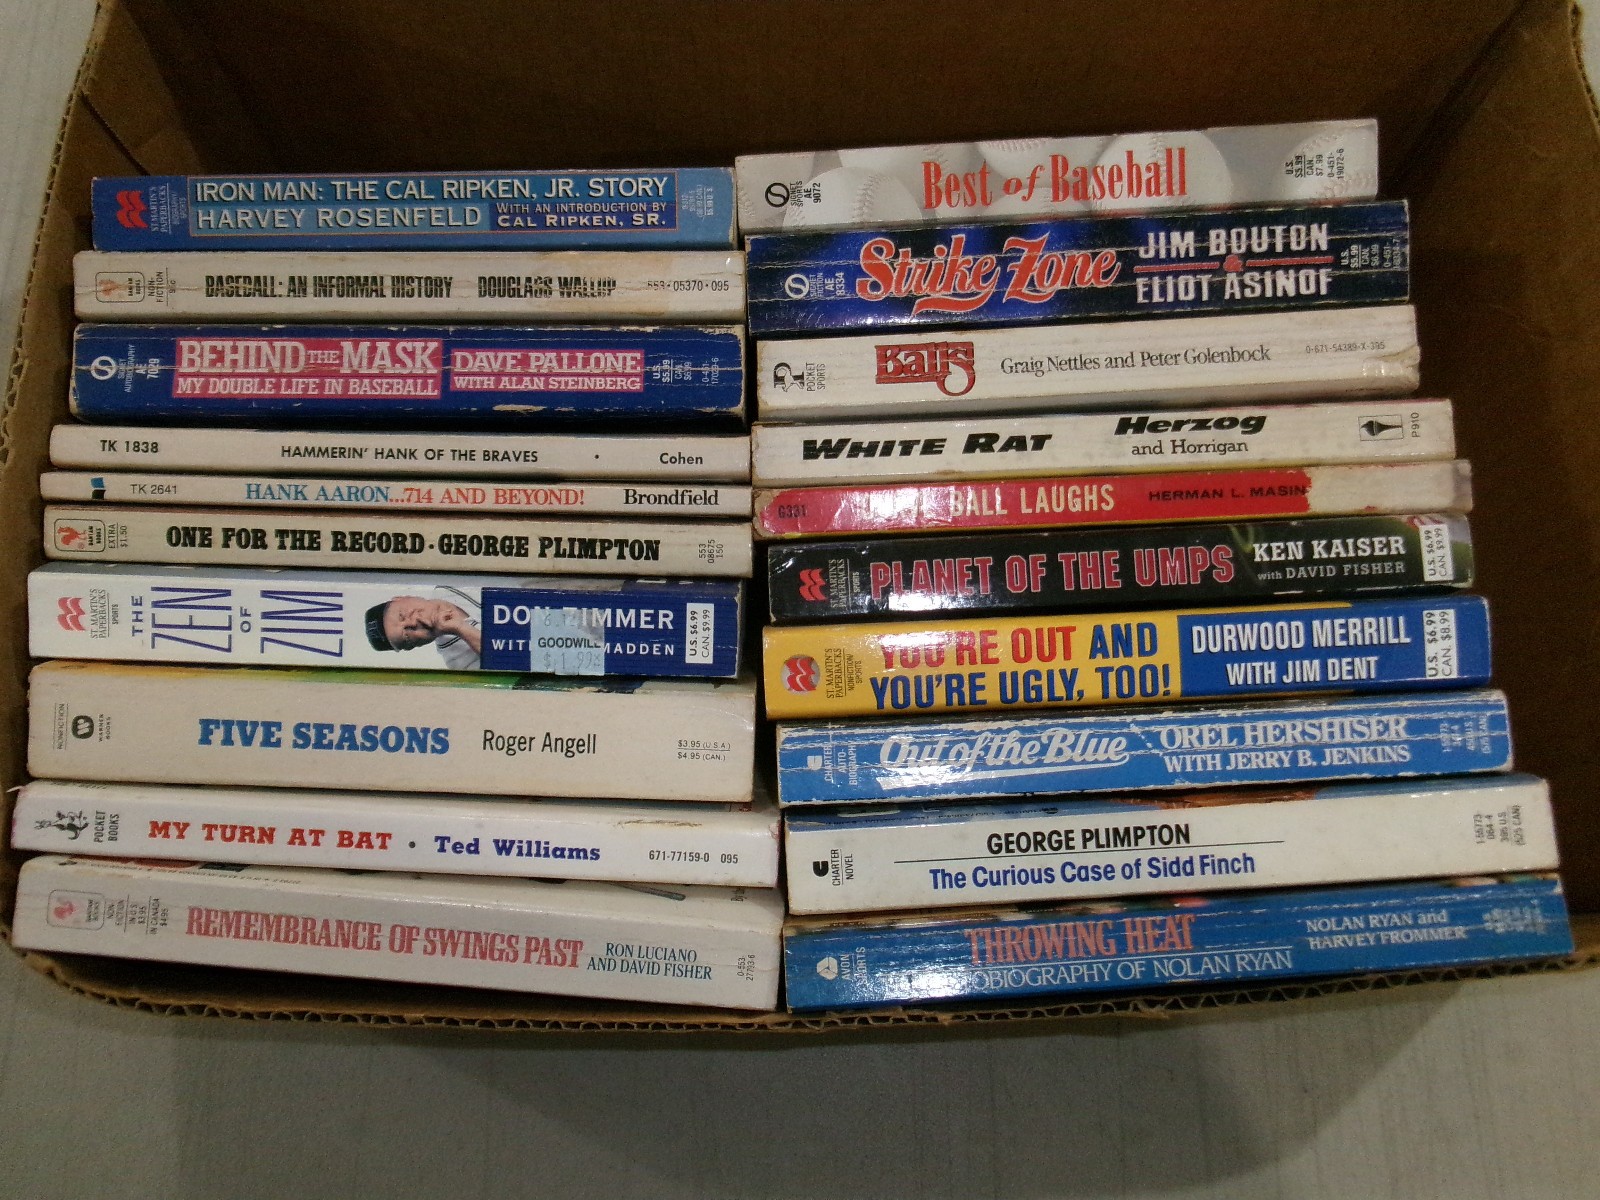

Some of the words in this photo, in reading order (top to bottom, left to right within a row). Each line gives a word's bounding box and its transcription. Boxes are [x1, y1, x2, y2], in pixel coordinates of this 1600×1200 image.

[197, 182, 255, 202] IRON
[264, 181, 323, 201] MAN:
[331, 180, 378, 200] THE
[385, 180, 434, 200] CAL
[442, 179, 536, 201] RIPKEN,
[545, 178, 580, 198] JR.
[588, 177, 668, 198] STORY
[922, 159, 993, 209] Best
[1003, 165, 1046, 201] of
[1049, 147, 1187, 203] Baseball
[813, 182, 822, 204] 9072
[198, 208, 305, 229] HARVEY
[317, 207, 482, 228] ROSENFELD
[556, 202, 646, 212] INTRODUCTION
[545, 214, 624, 228] RIPKEN,
[1138, 231, 1194, 258] JIM
[1209, 223, 1328, 256] BOUTON
[856, 234, 1001, 303] Strike
[1002, 232, 1122, 303] Zone
[205, 275, 283, 298] BASEBALL:
[287, 275, 308, 298] AN
[313, 275, 386, 298] INFORMAL
[391, 275, 453, 298] HISTORY
[836, 272, 844, 296] 8334
[1136, 275, 1212, 303] ELIOT
[1224, 268, 1333, 300] ASINOF
[179, 341, 305, 374] BEHIND
[308, 350, 340, 365] THE
[340, 341, 438, 374] MASK
[454, 352, 521, 373] DAVE
[530, 352, 641, 373] PALLONE
[875, 341, 976, 397] Balls
[1000, 357, 1043, 377] Graig
[1046, 353, 1100, 372] Nettles
[1105, 353, 1136, 369] and
[1140, 350, 1181, 368] Peter
[1183, 344, 1271, 366] Golenbock
[176, 378, 202, 395] MY
[208, 379, 275, 395] DOUBLE
[280, 379, 319, 395] LIFE
[348, 379, 438, 396] BASEBALL
[454, 376, 495, 389] WITH
[499, 377, 544, 390] ALAN
[548, 377, 642, 390] STEINBERG
[1114, 414, 1267, 436] Herzog
[100, 440, 118, 452] TK
[124, 441, 159, 453] 1838
[281, 446, 368, 459] HAMMERIN'
[374, 447, 418, 460] HANK
[482, 450, 538, 462] BRAVES
[659, 452, 703, 465] Cohen
[802, 437, 947, 460] WHITE
[962, 433, 1053, 455] RAT
[1170, 439, 1248, 456] Horrigan
[129, 483, 147, 495] TK
[150, 483, 178, 495] 2641
[246, 484, 310, 501] HANK
[440, 488, 486, 505] AND
[494, 488, 584, 506] BEYOND!
[623, 488, 719, 506] Brondfield
[951, 487, 1008, 518] BALL
[1020, 484, 1115, 514] LAUGHS
[1148, 488, 1224, 502] HERMAN
[1250, 486, 1307, 498] MASIN
[166, 526, 212, 549] ONE
[221, 528, 268, 551] FOR
[275, 529, 321, 551] THE
[331, 530, 425, 554] RECORD
[437, 533, 529, 557] GEORGE
[538, 536, 661, 561] PLIMPTON
[1253, 541, 1303, 562] KEN
[1312, 536, 1406, 560] KAISER
[1424, 530, 1435, 554] $6.99
[869, 556, 994, 600] PLANET
[1005, 554, 1047, 593] OF
[1058, 550, 1122, 591] THE
[1134, 544, 1235, 587] UMPS
[1285, 564, 1336, 579] DAVID
[1343, 561, 1406, 577] FISHER
[151, 587, 232, 653] ZEN
[260, 590, 343, 657] ZIM
[690, 610, 698, 635] $6.99
[702, 609, 711, 633] $9.99
[1439, 611, 1451, 641] $8.99
[1011, 625, 1077, 665] OUT
[1088, 621, 1158, 660] AND
[1192, 620, 1306, 654] DURWOOD
[1312, 615, 1411, 648] MERRILL
[1226, 662, 1276, 685] WITH
[1282, 659, 1320, 684] JIM
[1327, 656, 1379, 681] DENT
[1427, 652, 1438, 677] U.S.
[870, 671, 988, 711] YOU'RE
[999, 667, 1085, 706] UGLY,
[1094, 664, 1171, 698] TOO!
[198, 718, 283, 749] FIVE
[292, 721, 450, 755] SEASONS
[483, 729, 536, 757] Roger
[541, 731, 597, 758] Angell
[677, 740, 701, 748] $3.95
[1041, 727, 1128, 764] Blue
[1160, 725, 1239, 750] OREL
[1244, 717, 1409, 746] HERSHISER
[677, 751, 701, 760] $4.95
[1163, 754, 1222, 774] WITH
[1226, 752, 1293, 771] JERRY
[1321, 745, 1411, 766] JENKINS
[94, 810, 106, 843] POCKET
[108, 813, 120, 841] BOOKS
[148, 821, 191, 839] MY
[201, 823, 276, 845] TURN
[287, 828, 326, 847] AT
[337, 830, 393, 850] BAT
[987, 830, 1075, 855] GEORGE
[1082, 824, 1190, 849] PLIMPTON
[434, 835, 480, 855] Ted
[493, 838, 601, 862] Williams
[648, 850, 710, 863] 671-77159-0
[720, 853, 739, 864] 095
[831, 848, 841, 886] CHARTER
[845, 853, 854, 880] NOVEL
[929, 868, 966, 889] The
[972, 864, 1055, 887] Curious
[1060, 861, 1116, 884] Case
[1121, 858, 1142, 881] of
[1146, 855, 1194, 878] Sidd
[1199, 852, 1255, 875] Finch
[186, 905, 382, 952] REMEMBRANCE
[389, 923, 421, 954] OF
[423, 927, 521, 963] SWINGS
[523, 936, 585, 969] PAST
[1306, 917, 1363, 933] NOLAN
[1369, 914, 1412, 930] RYAN
[964, 920, 1117, 966] THROWING
[1124, 913, 1196, 954] HEAT
[1308, 932, 1378, 950] HARVEY
[1380, 925, 1468, 946] FROMMER
[605, 942, 635, 958] RON
[637, 944, 698, 963] LUCIANO
[1154, 953, 1231, 978] NOLAN
[1236, 949, 1293, 973] RYAN
[587, 956, 618, 972] AND
[620, 959, 660, 976] DAVID
[663, 962, 713, 981] FISHER
[841, 954, 852, 981] AVON
